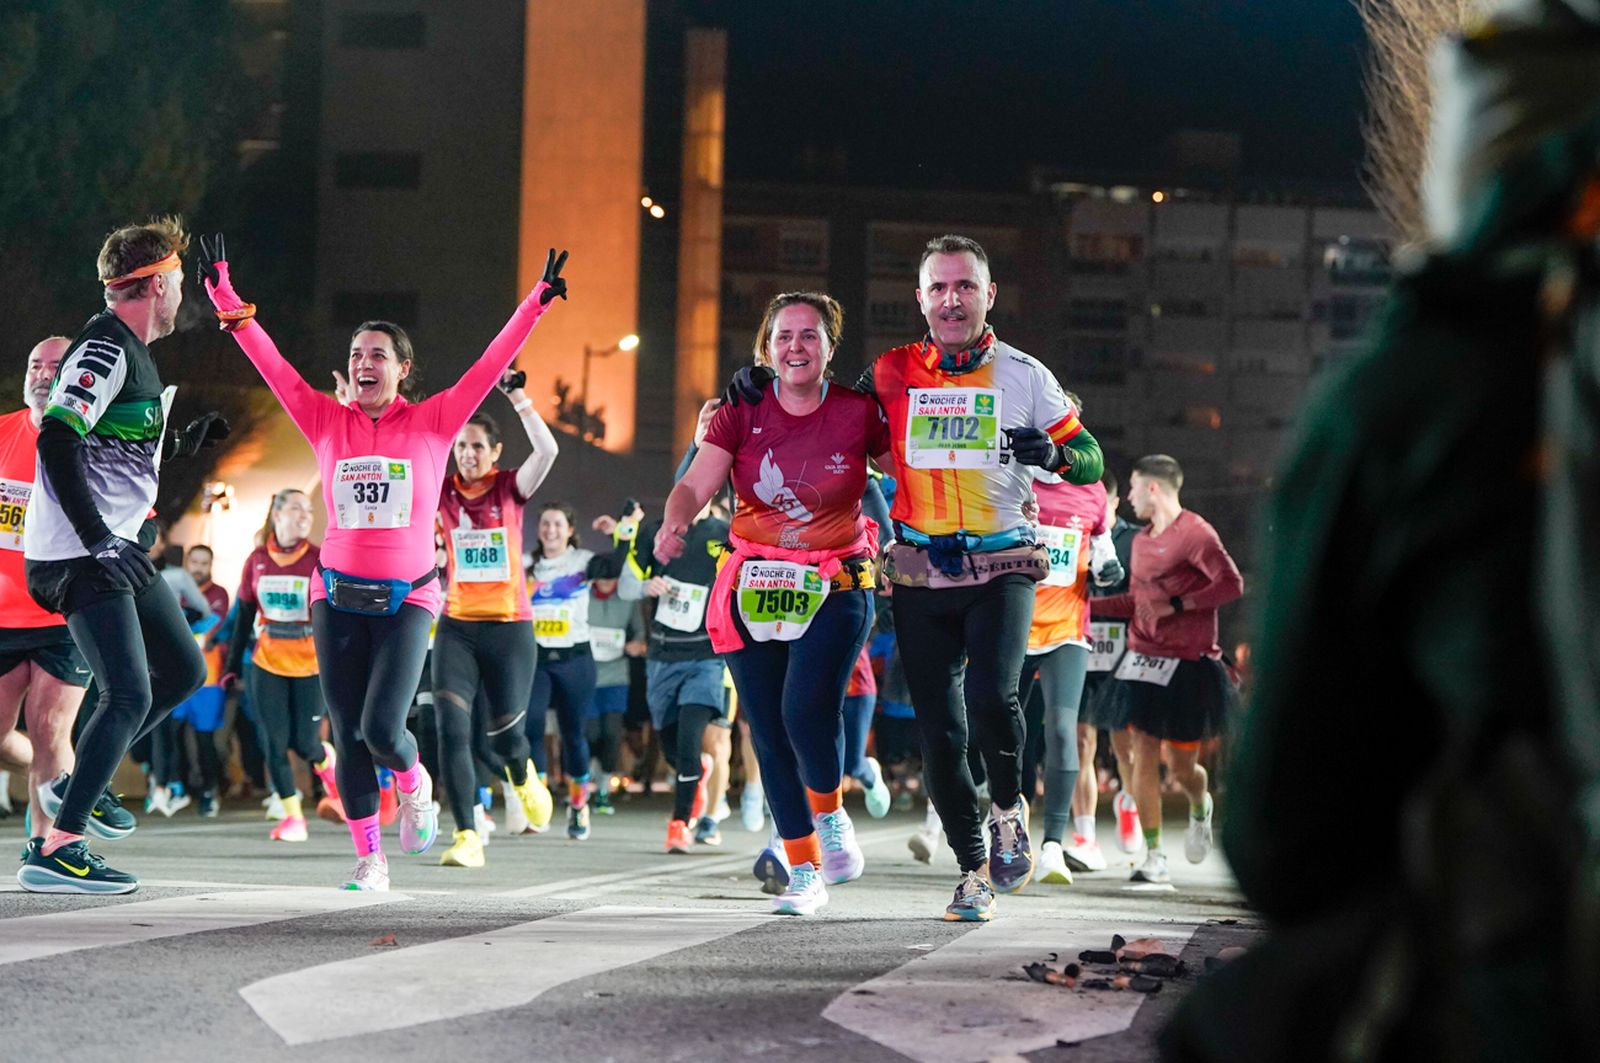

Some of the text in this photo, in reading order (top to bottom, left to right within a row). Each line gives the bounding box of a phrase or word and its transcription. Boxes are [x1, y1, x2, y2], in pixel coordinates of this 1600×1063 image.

[918, 407, 936, 415] SAN
[928, 416, 979, 440] 7102
[349, 464, 371, 472] NOCHE
[353, 482, 390, 503] 337
[0, 504, 27, 527] 56
[1048, 547, 1069, 566] 34
[759, 570, 784, 578] NOCHE
[786, 570, 797, 579] DE
[749, 580, 765, 588] SAN
[755, 589, 810, 615] 7503
[1132, 656, 1167, 670] 3201
